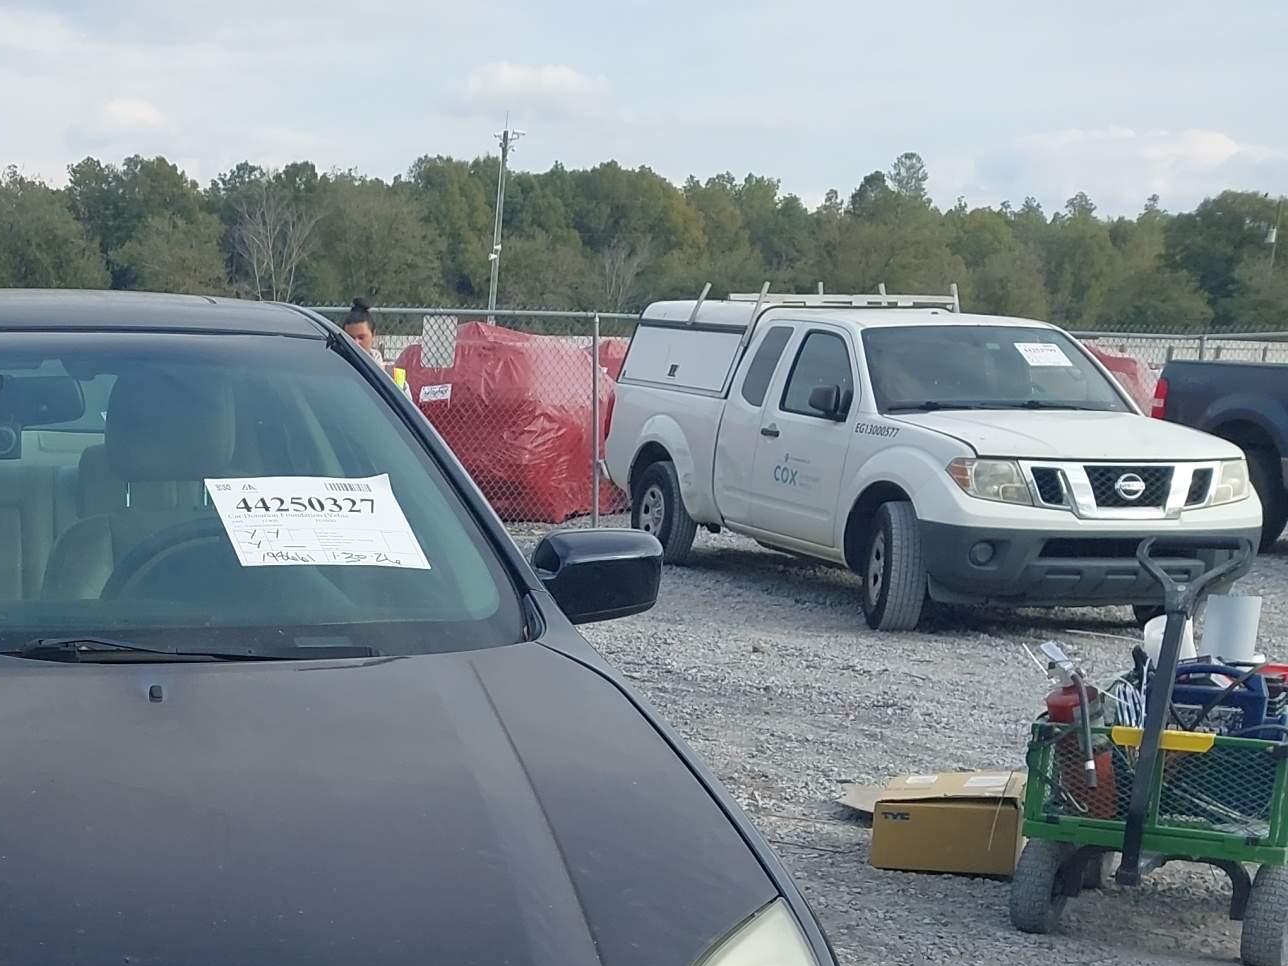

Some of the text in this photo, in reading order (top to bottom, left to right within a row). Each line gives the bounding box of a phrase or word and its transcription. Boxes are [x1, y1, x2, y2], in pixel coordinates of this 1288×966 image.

[854, 422, 900, 439] EG13000577
[773, 464, 798, 487] COX
[235, 497, 375, 514] 44250327
